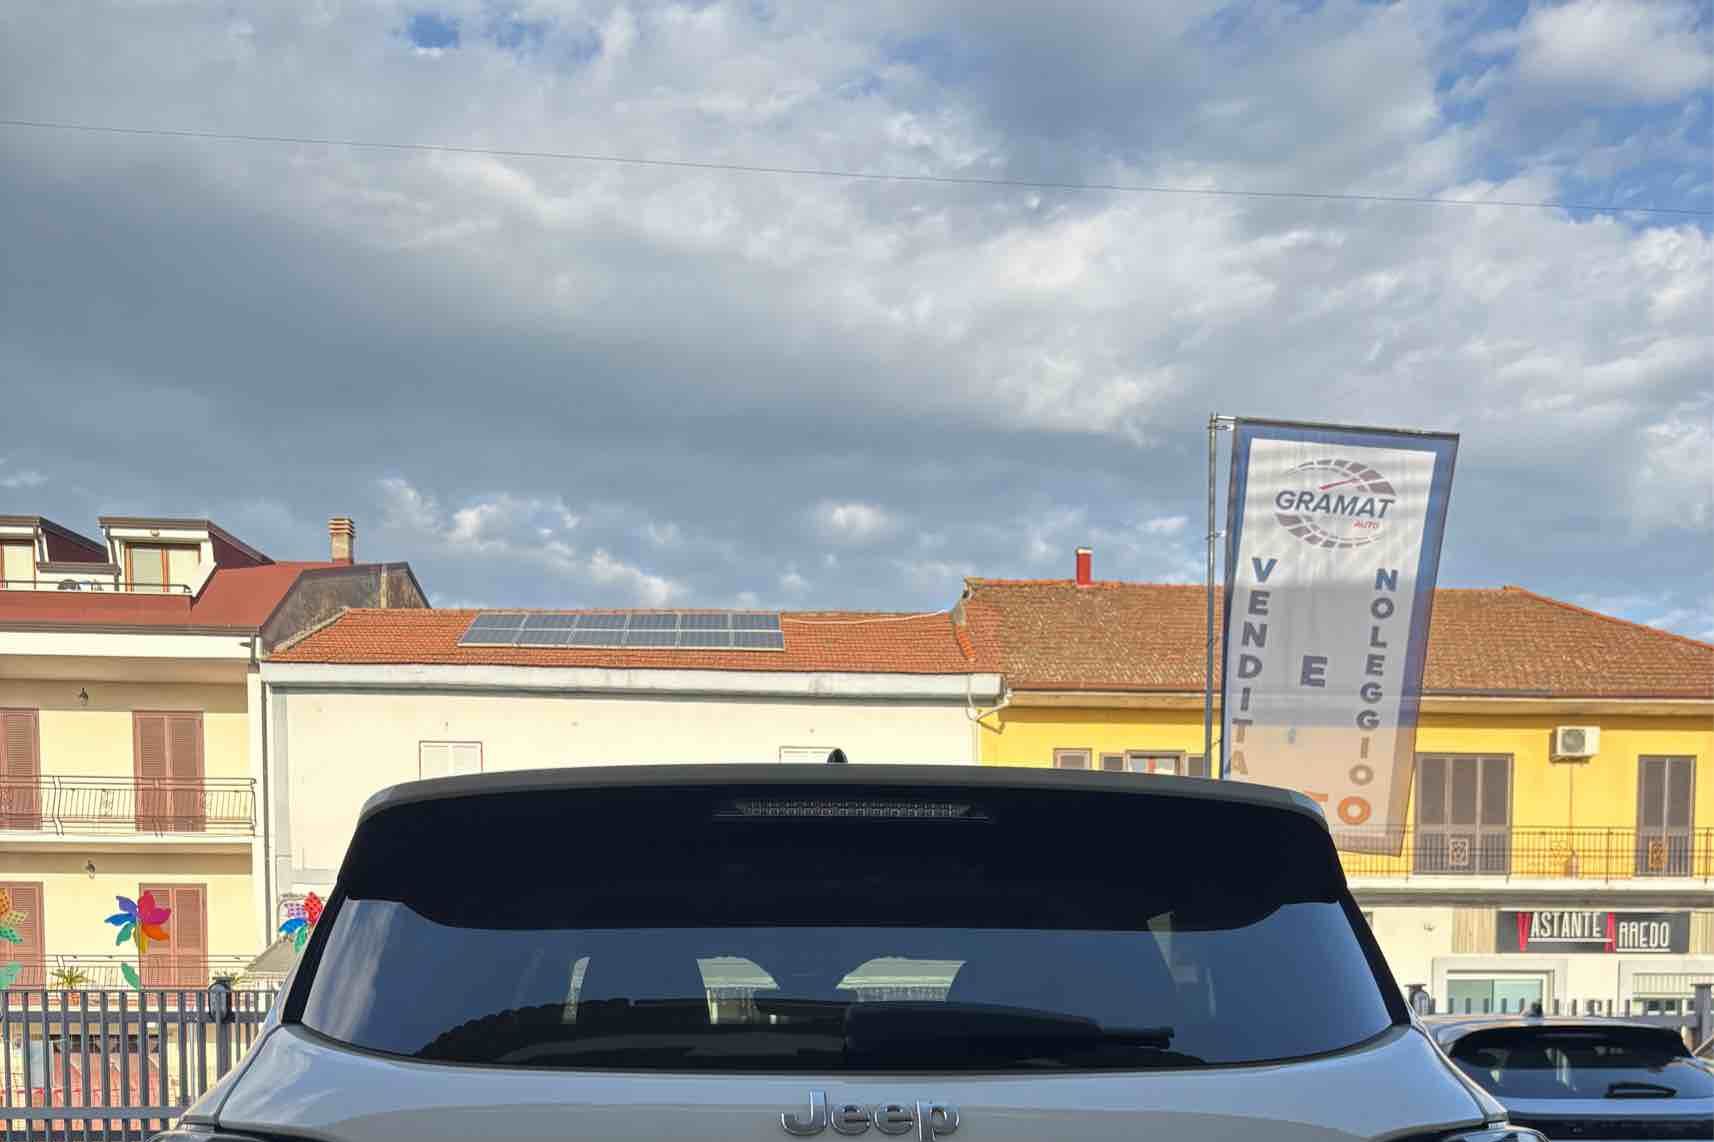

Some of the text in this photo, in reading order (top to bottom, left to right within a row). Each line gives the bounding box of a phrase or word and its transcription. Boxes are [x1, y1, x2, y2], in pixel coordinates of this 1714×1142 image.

[1275, 490, 1396, 519] GRAMAT
[1231, 557, 1278, 775] VENDITA
[1300, 655, 1328, 688] E
[1349, 568, 1398, 786] NOLEGGIO
